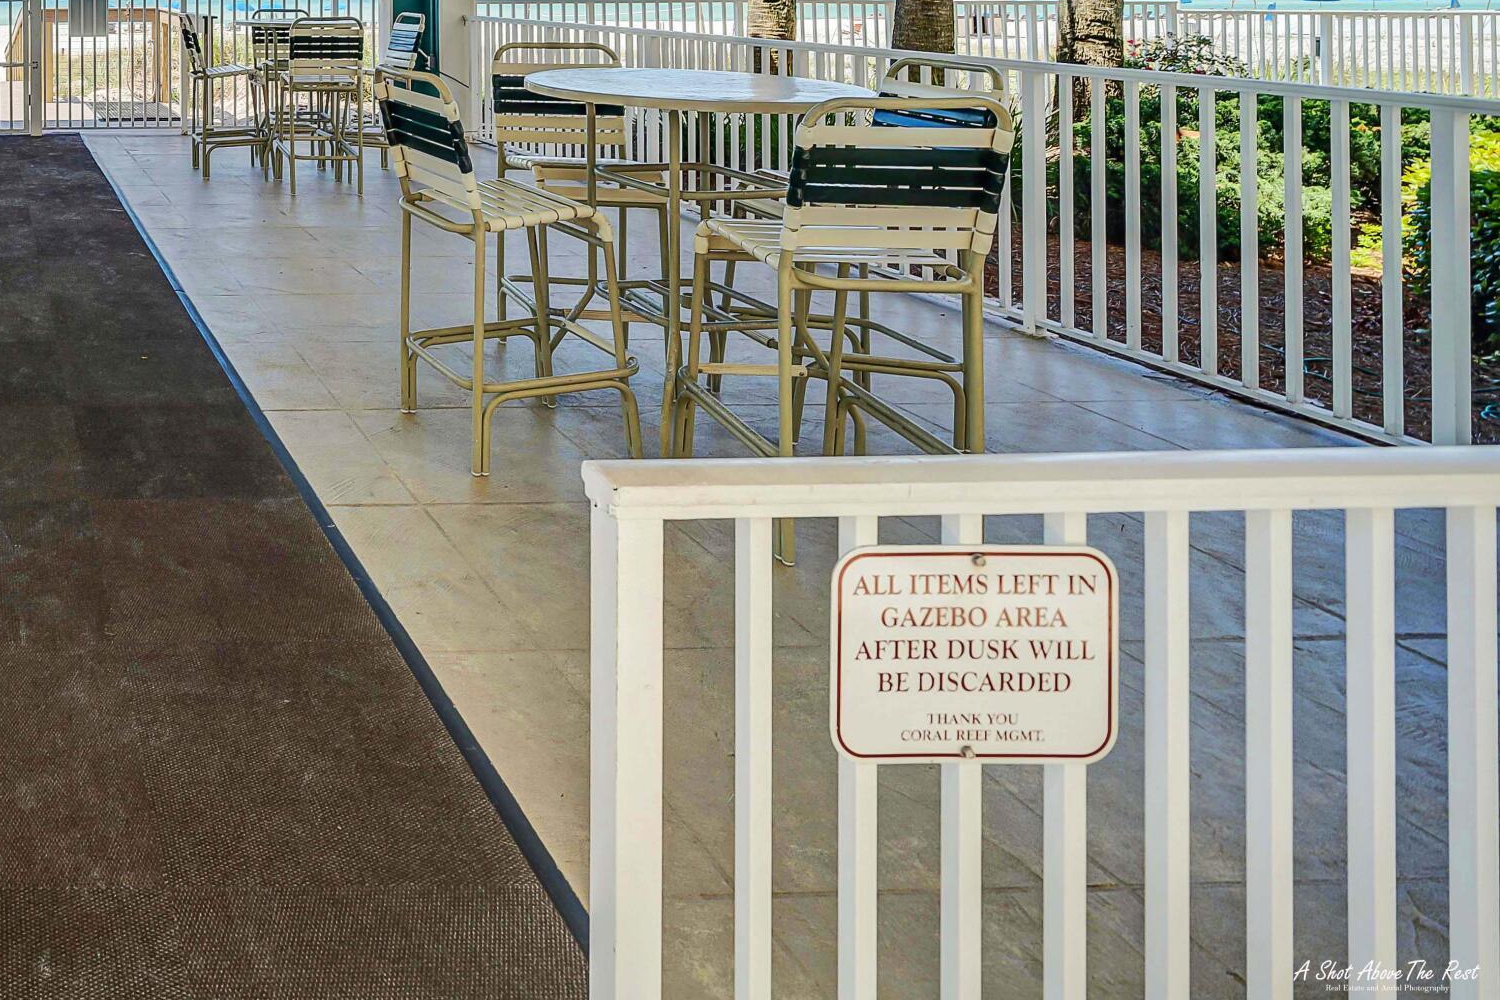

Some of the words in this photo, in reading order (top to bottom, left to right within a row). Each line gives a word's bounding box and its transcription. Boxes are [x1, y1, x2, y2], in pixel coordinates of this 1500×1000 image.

[852, 574, 902, 595] ALL
[909, 574, 989, 595] ITEMS
[996, 574, 1060, 595] LEFT
[1067, 574, 1097, 595] IN
[880, 606, 988, 627] GAZEBO
[995, 607, 1068, 627] AREA
[854, 639, 939, 660] AFTER
[946, 639, 1020, 660] DUSK
[1028, 640, 1096, 660] WILL
[877, 672, 910, 693] BE
[917, 672, 1072, 693] DISCARDED
[926, 713, 982, 725] THANK
[987, 713, 1019, 725] YOU
[900, 729, 951, 742] CORAL
[956, 729, 992, 742] REEF
[995, 730, 1045, 742] MGMT.
